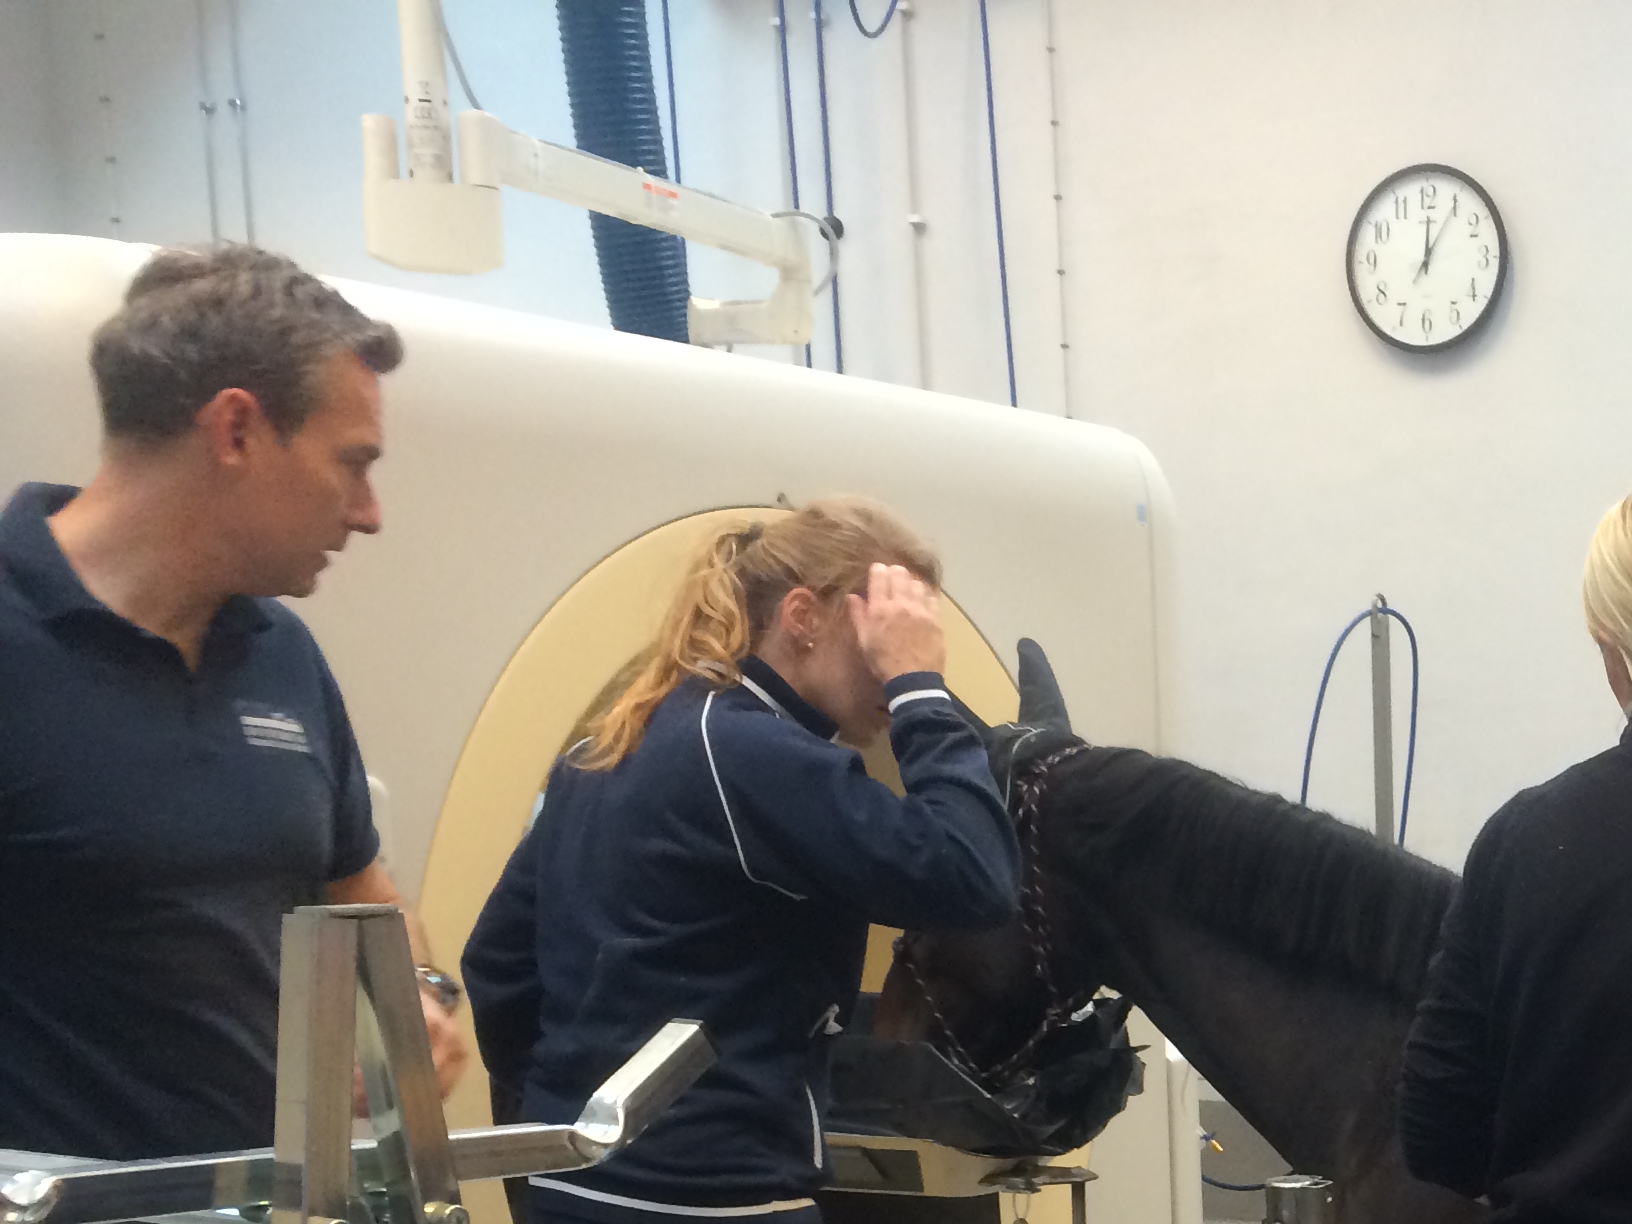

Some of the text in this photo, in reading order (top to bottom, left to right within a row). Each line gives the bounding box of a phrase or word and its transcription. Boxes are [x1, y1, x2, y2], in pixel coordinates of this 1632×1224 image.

[1393, 196, 1408, 220] 11
[1420, 184, 1437, 210] 12
[1374, 220, 1391, 245] 10
[1467, 212, 1480, 238] 2
[1366, 249, 1378, 275] 9
[1477, 244, 1490, 270] 3
[1375, 280, 1388, 306] 8
[1466, 277, 1478, 303] 4
[1396, 302, 1408, 327] 7
[1421, 308, 1433, 334] 6
[1449, 300, 1461, 325] 5
